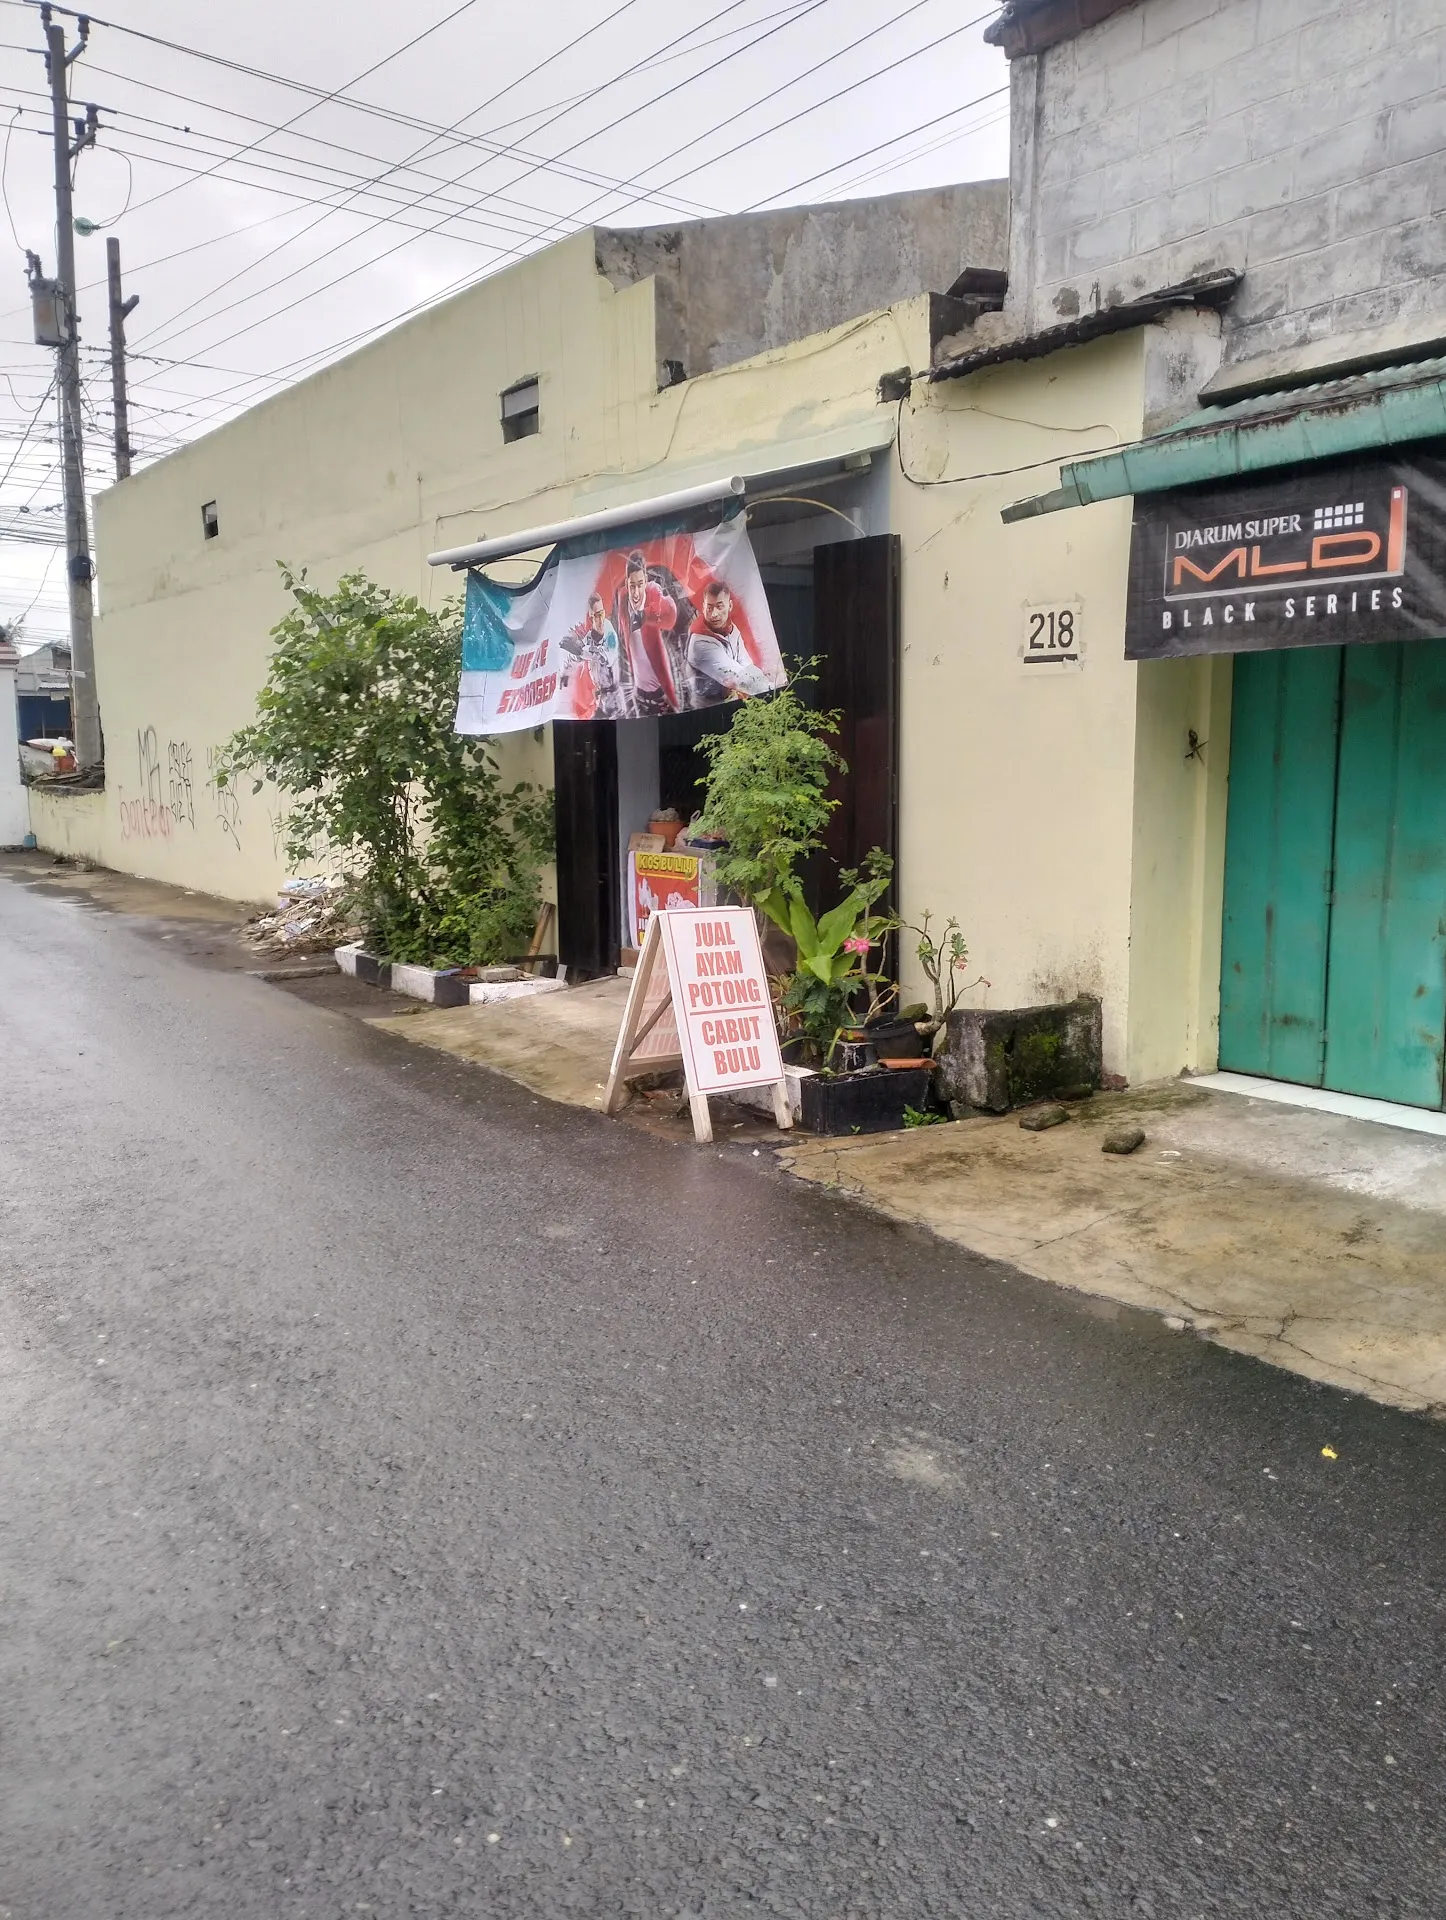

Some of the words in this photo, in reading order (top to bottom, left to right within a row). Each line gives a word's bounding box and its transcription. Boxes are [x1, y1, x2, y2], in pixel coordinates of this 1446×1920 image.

[1174, 522, 1242, 550] DJARUM
[1244, 513, 1302, 537] SUPER
[1162, 601, 1256, 630] BLACK
[1284, 587, 1405, 618] SERIES
[1028, 609, 1075, 650] 218
[496, 671, 557, 715] STRONGER
[639, 854, 660, 870] KIOS
[660, 856, 673, 872] BU
[694, 921, 736, 948] JUAL
[696, 950, 744, 978] AYAM
[688, 978, 761, 1008] POTONG
[701, 1015, 762, 1047] CABUT
[713, 1045, 762, 1076] BULU
